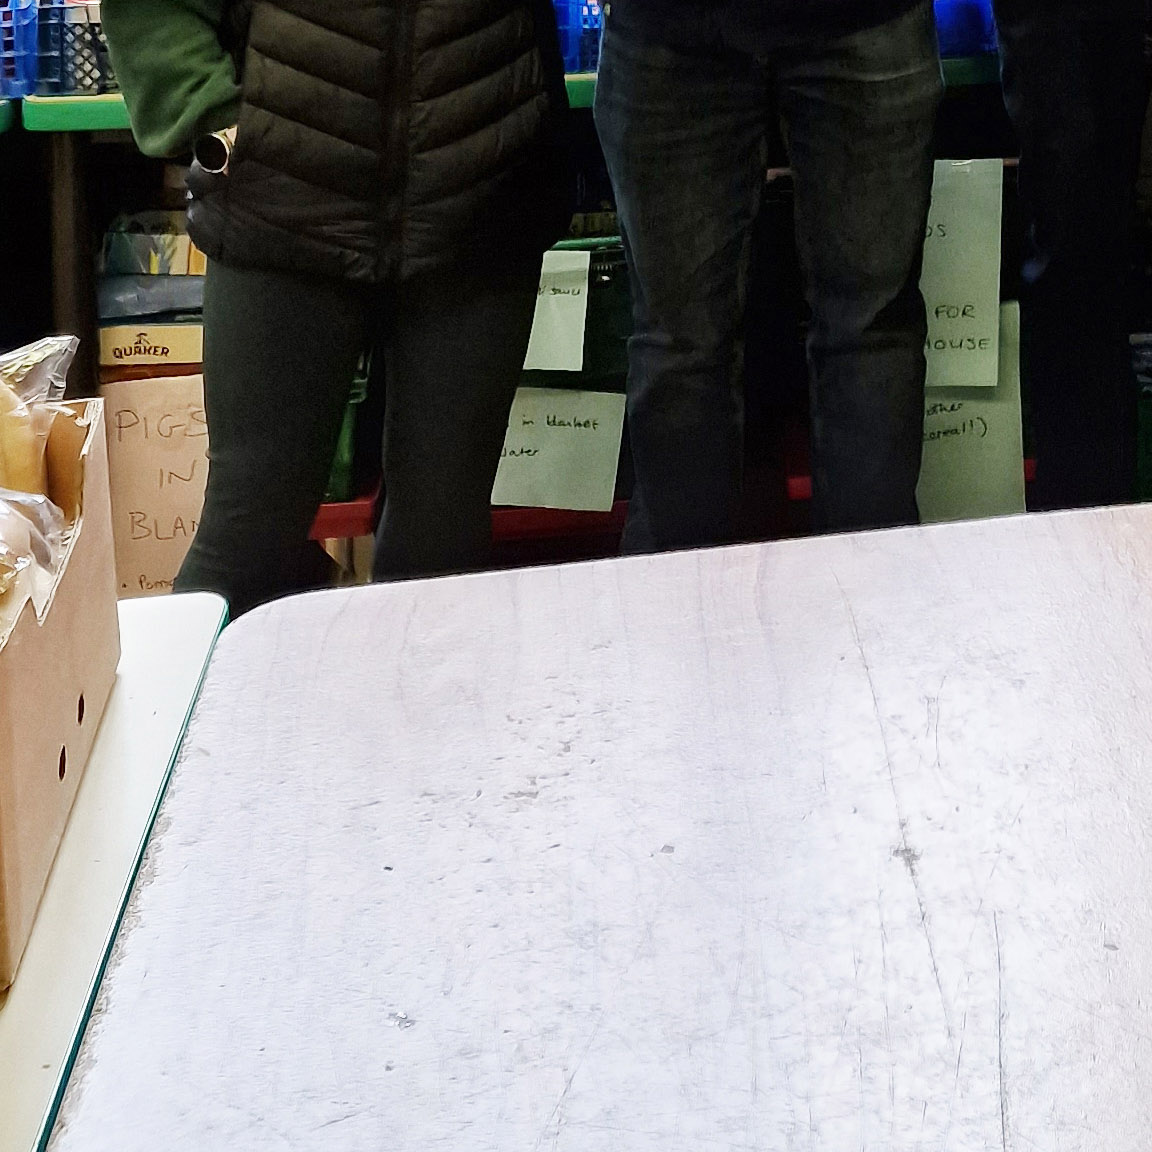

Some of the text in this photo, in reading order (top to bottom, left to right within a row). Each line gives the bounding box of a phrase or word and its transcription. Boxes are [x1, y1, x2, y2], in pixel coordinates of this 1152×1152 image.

[934, 304, 976, 319] FOR
[112, 345, 170, 359] QUAKER
[115, 408, 207, 442] PIGS
[159, 459, 197, 489] IN
